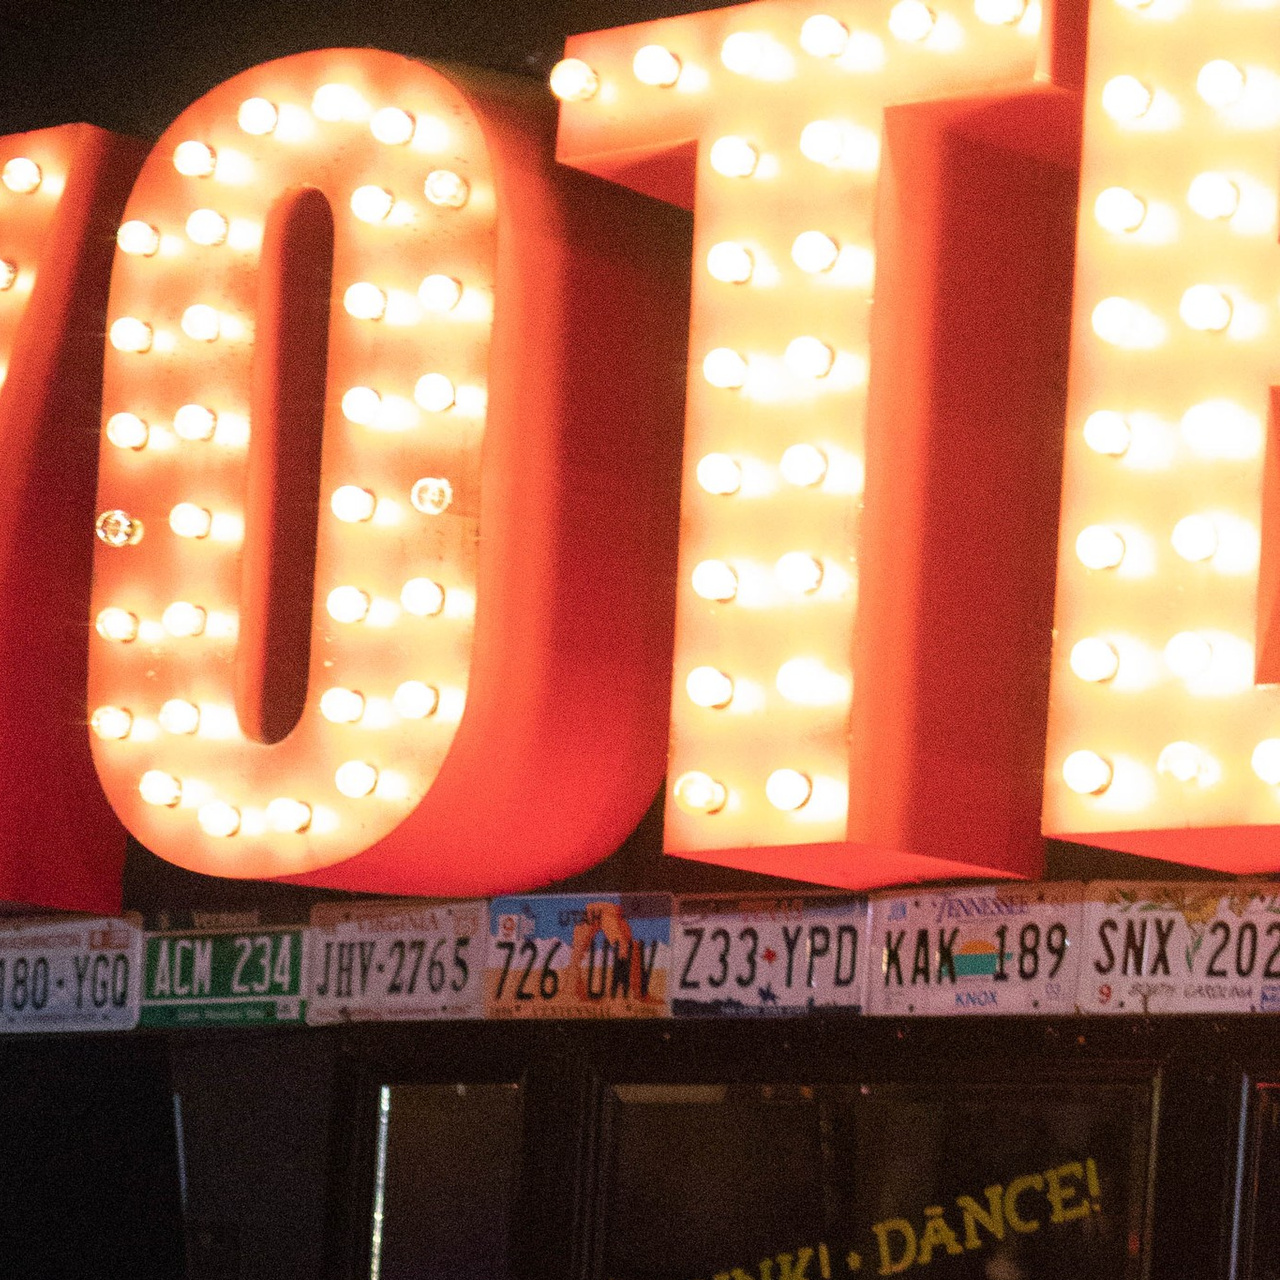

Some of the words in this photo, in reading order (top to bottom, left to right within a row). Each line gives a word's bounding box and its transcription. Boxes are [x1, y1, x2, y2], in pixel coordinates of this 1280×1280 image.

[153, 938, 213, 996] ACM
[231, 934, 292, 993] 234
[494, 940, 562, 1001] 726
[883, 927, 960, 987] KAK
[992, 921, 1069, 982] 189
[1094, 918, 1176, 977] SNX
[954, 990, 998, 1007] KNOX
